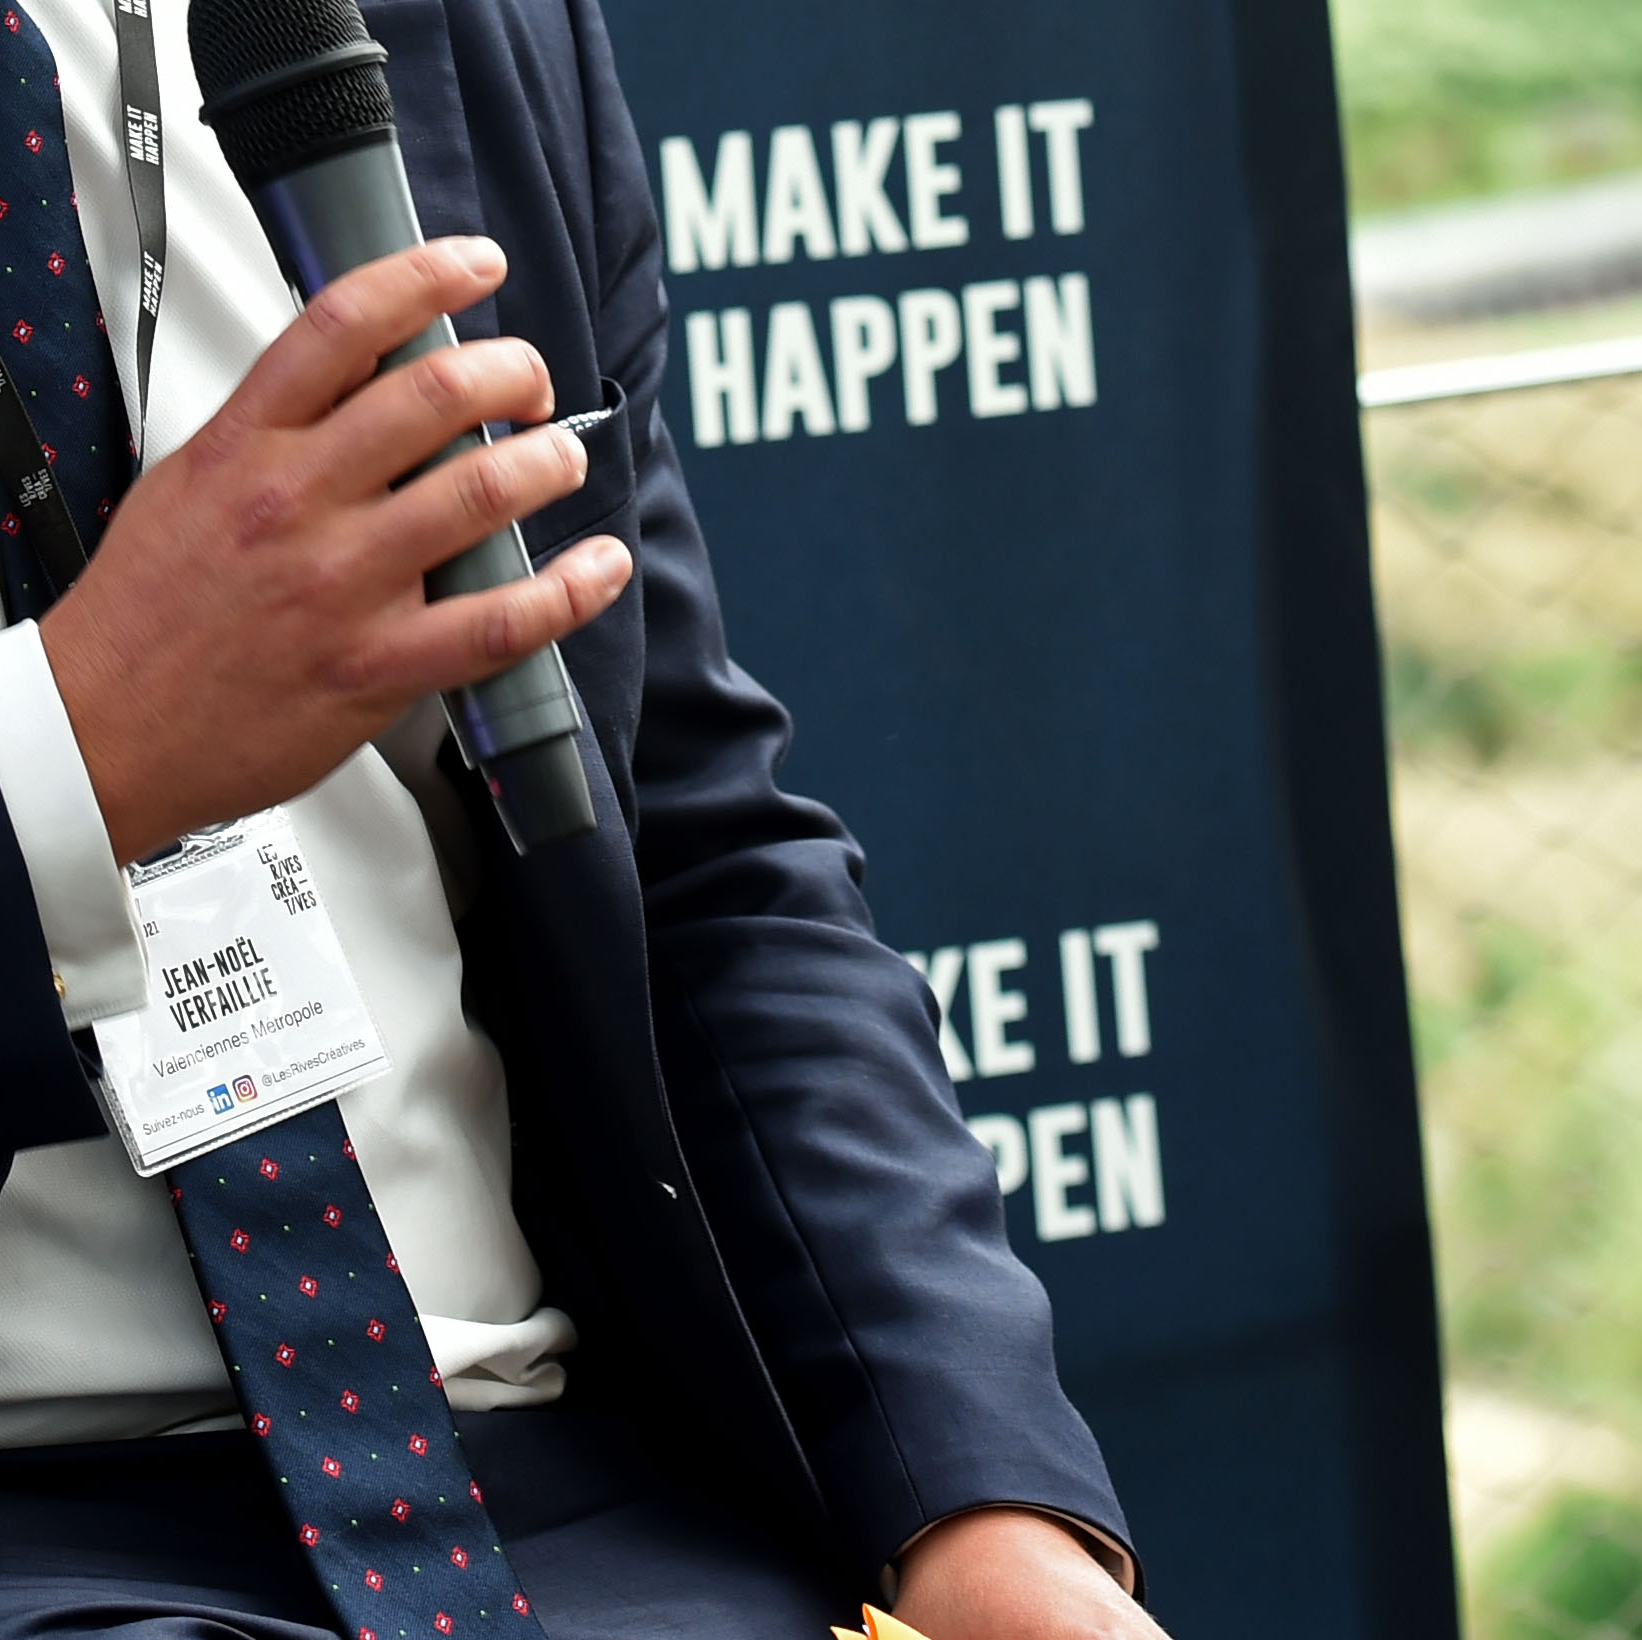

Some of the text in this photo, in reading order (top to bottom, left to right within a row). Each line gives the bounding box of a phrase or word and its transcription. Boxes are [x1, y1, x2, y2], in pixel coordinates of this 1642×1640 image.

[126, 104, 145, 161] MAKE IT
[143, 111, 160, 166] HAPPEN
[660, 99, 1093, 274] MAKE IT
[142, 251, 155, 311] MAKE IT
[149, 260, 163, 318] HAPPEN
[686, 273, 1096, 448] HAPPEN
[161, 935, 265, 999] JEAN-NOËL
[168, 966, 278, 1033] VERFAILLIE
[903, 921, 1160, 1083] KE IT
[152, 1001, 324, 1079] Valenciennes Métropole
[142, 1102, 206, 1136] Suivez-nous
[261, 1038, 367, 1088] @LesRivesCréatives
